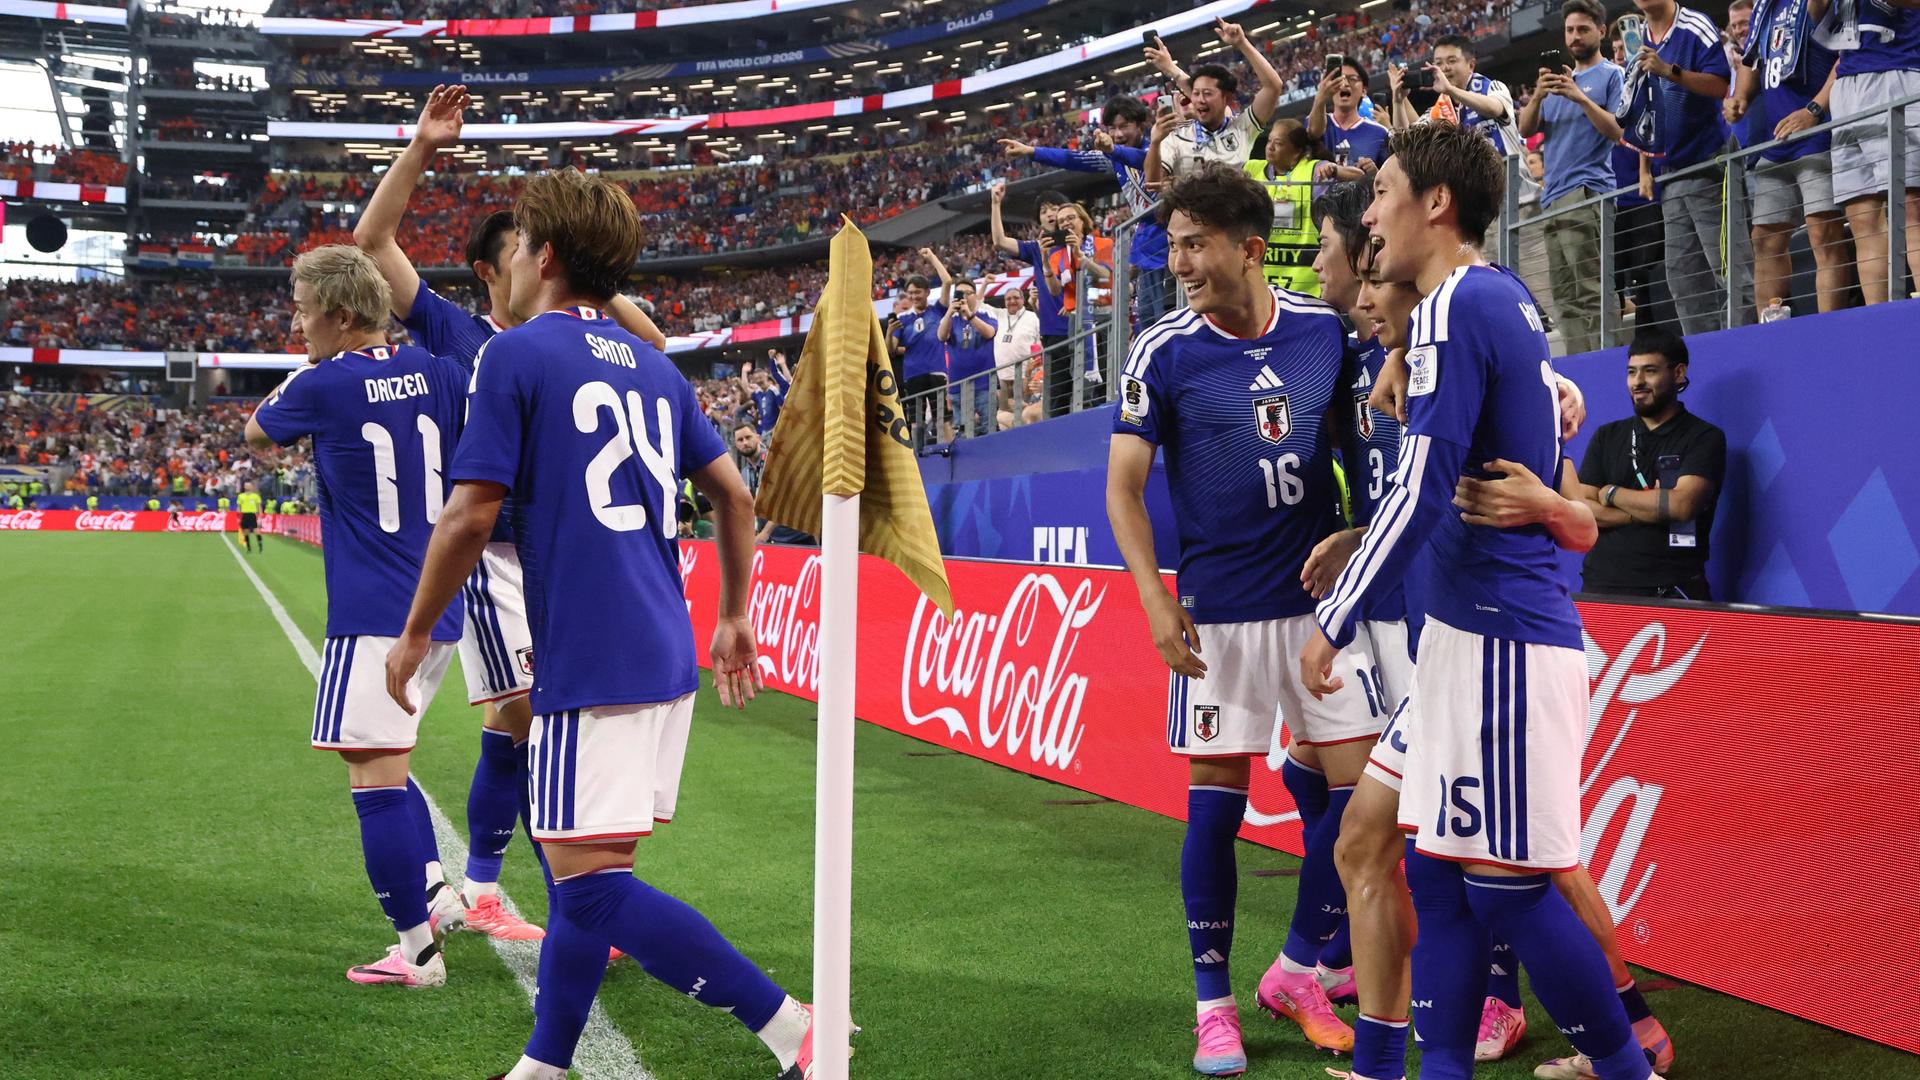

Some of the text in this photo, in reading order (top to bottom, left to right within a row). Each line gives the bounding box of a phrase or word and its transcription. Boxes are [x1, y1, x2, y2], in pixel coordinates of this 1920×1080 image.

[946, 10, 994, 32] DALLAS
[461, 72, 529, 82] DALLAS
[696, 50, 804, 71] FIFA WORLD CUP 2026
[1264, 247, 1302, 263] RITY
[585, 332, 637, 369] SANO
[365, 372, 429, 403] DAIZEN
[361, 413, 444, 533] 11
[572, 381, 678, 539] 24
[1258, 452, 1304, 509] 16
[902, 572, 1109, 771] Coca-Cola
[1436, 773, 1482, 838] 15
[1187, 919, 1229, 930] JAPAN
